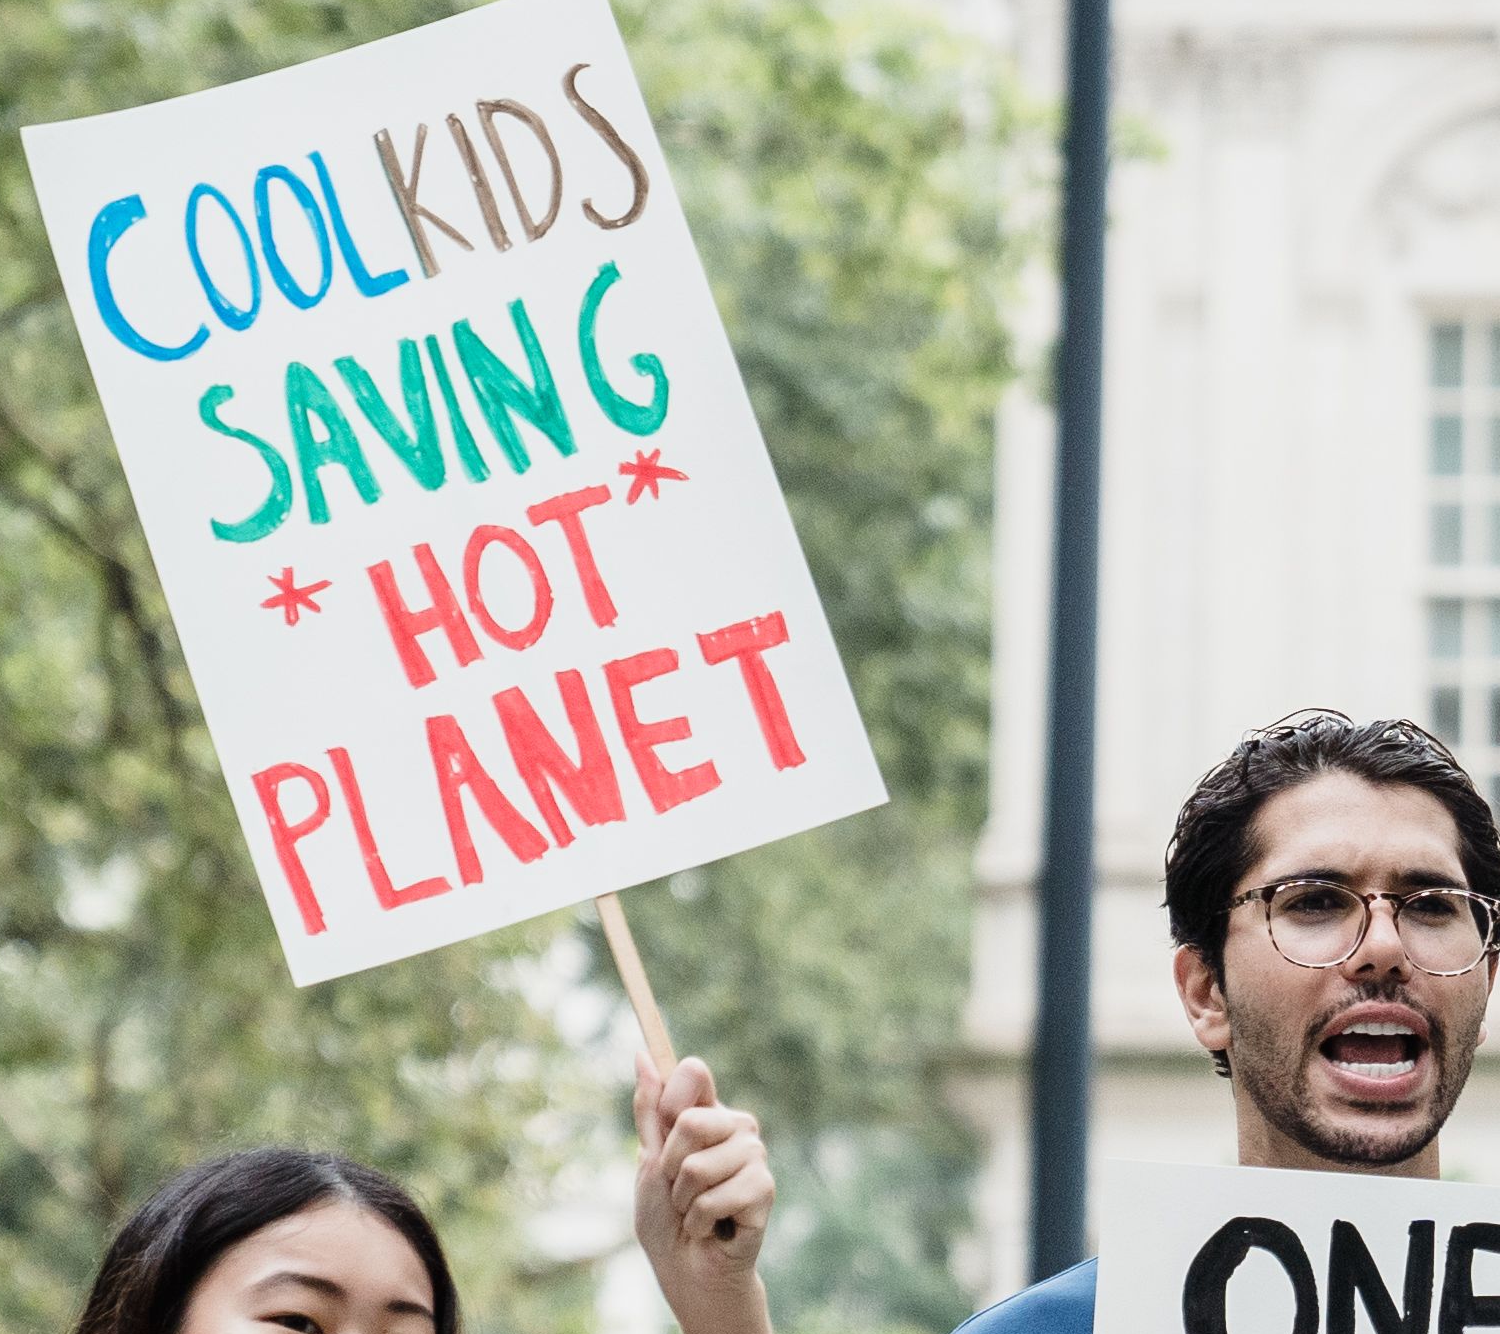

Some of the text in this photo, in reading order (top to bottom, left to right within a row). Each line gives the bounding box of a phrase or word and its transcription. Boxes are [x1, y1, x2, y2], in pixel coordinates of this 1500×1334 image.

[198, 260, 670, 544] SAVING
[366, 484, 619, 689] HOT
[251, 610, 807, 936] PLANET
